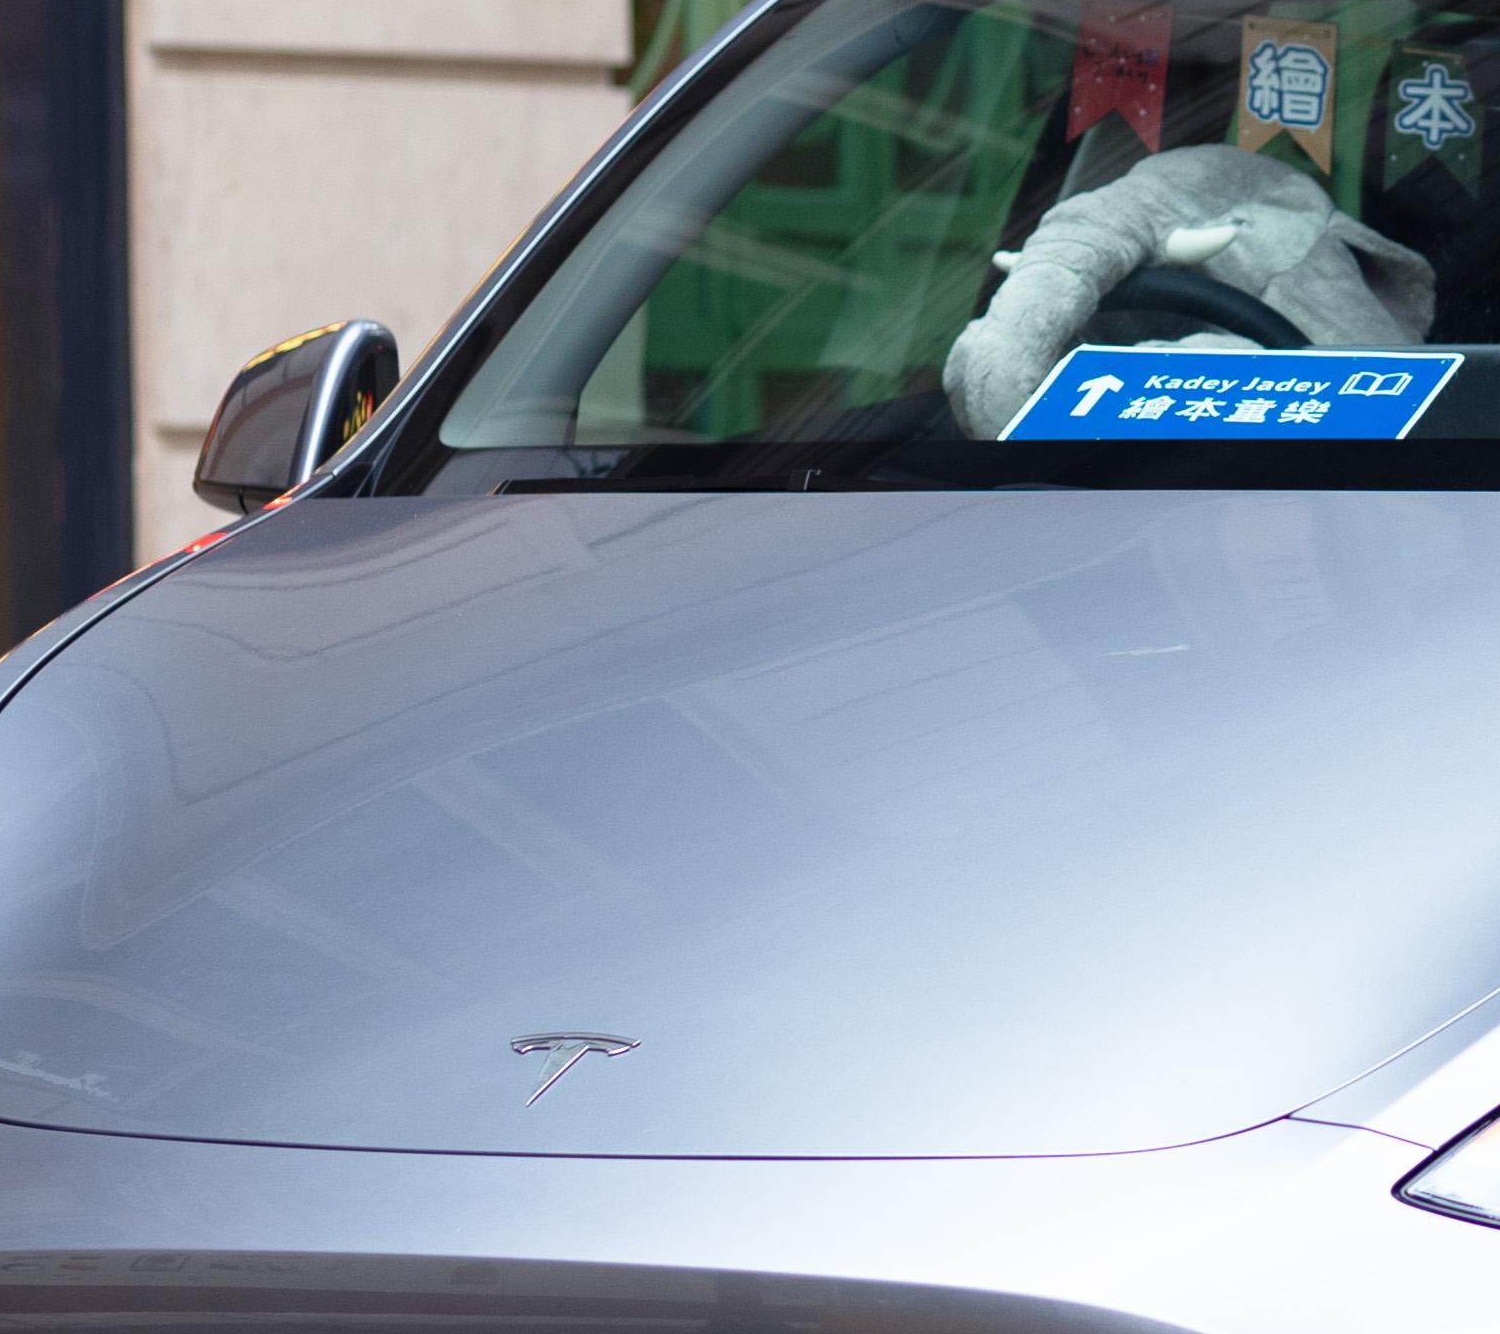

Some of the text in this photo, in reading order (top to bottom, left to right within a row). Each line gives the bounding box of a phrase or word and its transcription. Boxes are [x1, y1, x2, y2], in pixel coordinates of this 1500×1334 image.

[1248, 41, 1330, 127] 繪
[1395, 63, 1475, 150] 本
[1143, 374, 1331, 396] Kadey Jadey
[1118, 396, 1331, 424] 繪本童樂
